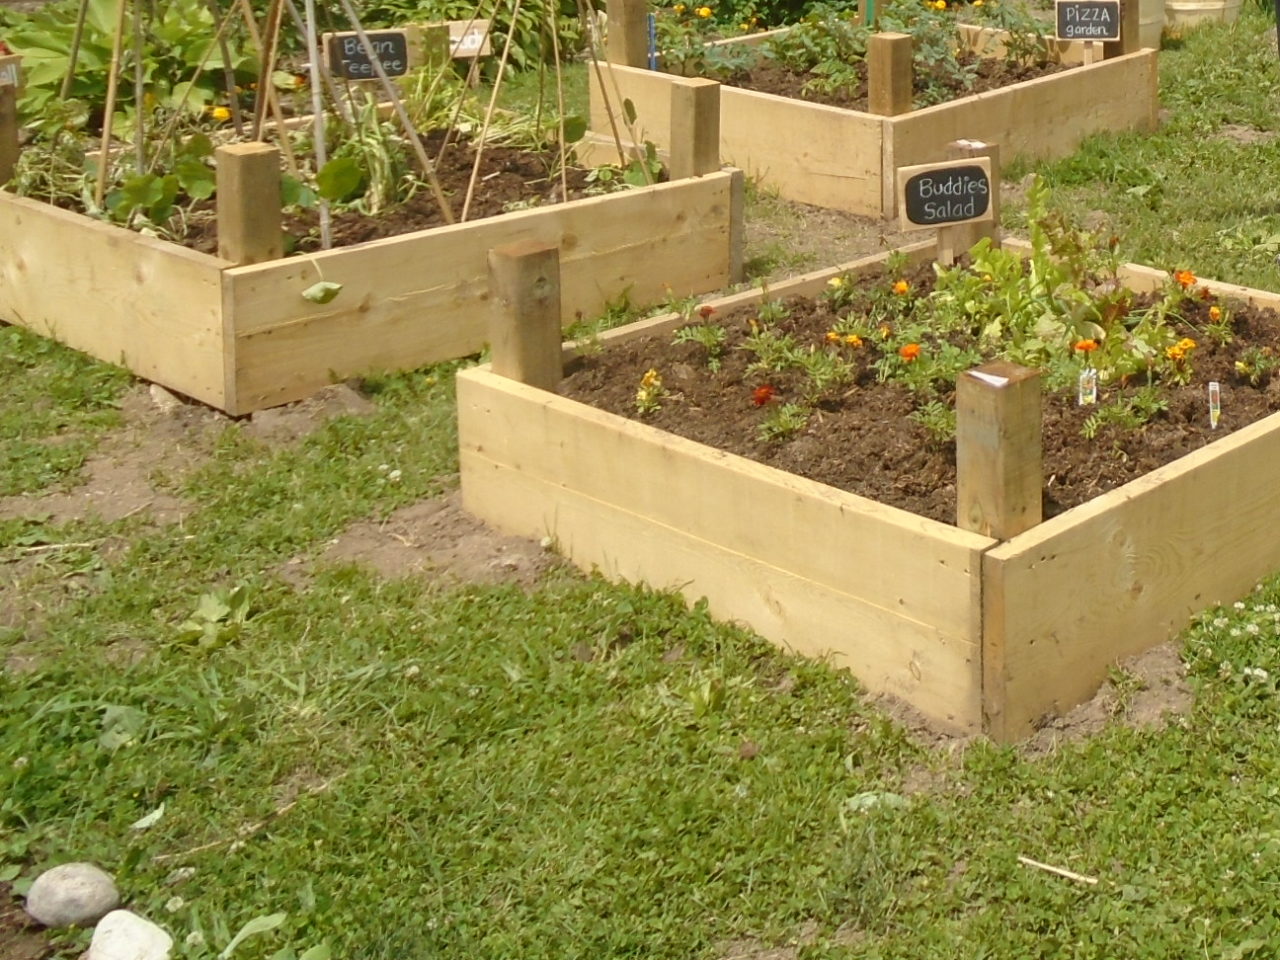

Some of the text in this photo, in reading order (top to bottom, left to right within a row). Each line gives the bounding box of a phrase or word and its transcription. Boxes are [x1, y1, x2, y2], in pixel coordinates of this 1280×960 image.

[1066, 22, 1109, 37] garden
[343, 38, 395, 55] Bean
[919, 176, 988, 199] Buddies
[924, 196, 975, 220] Salad
